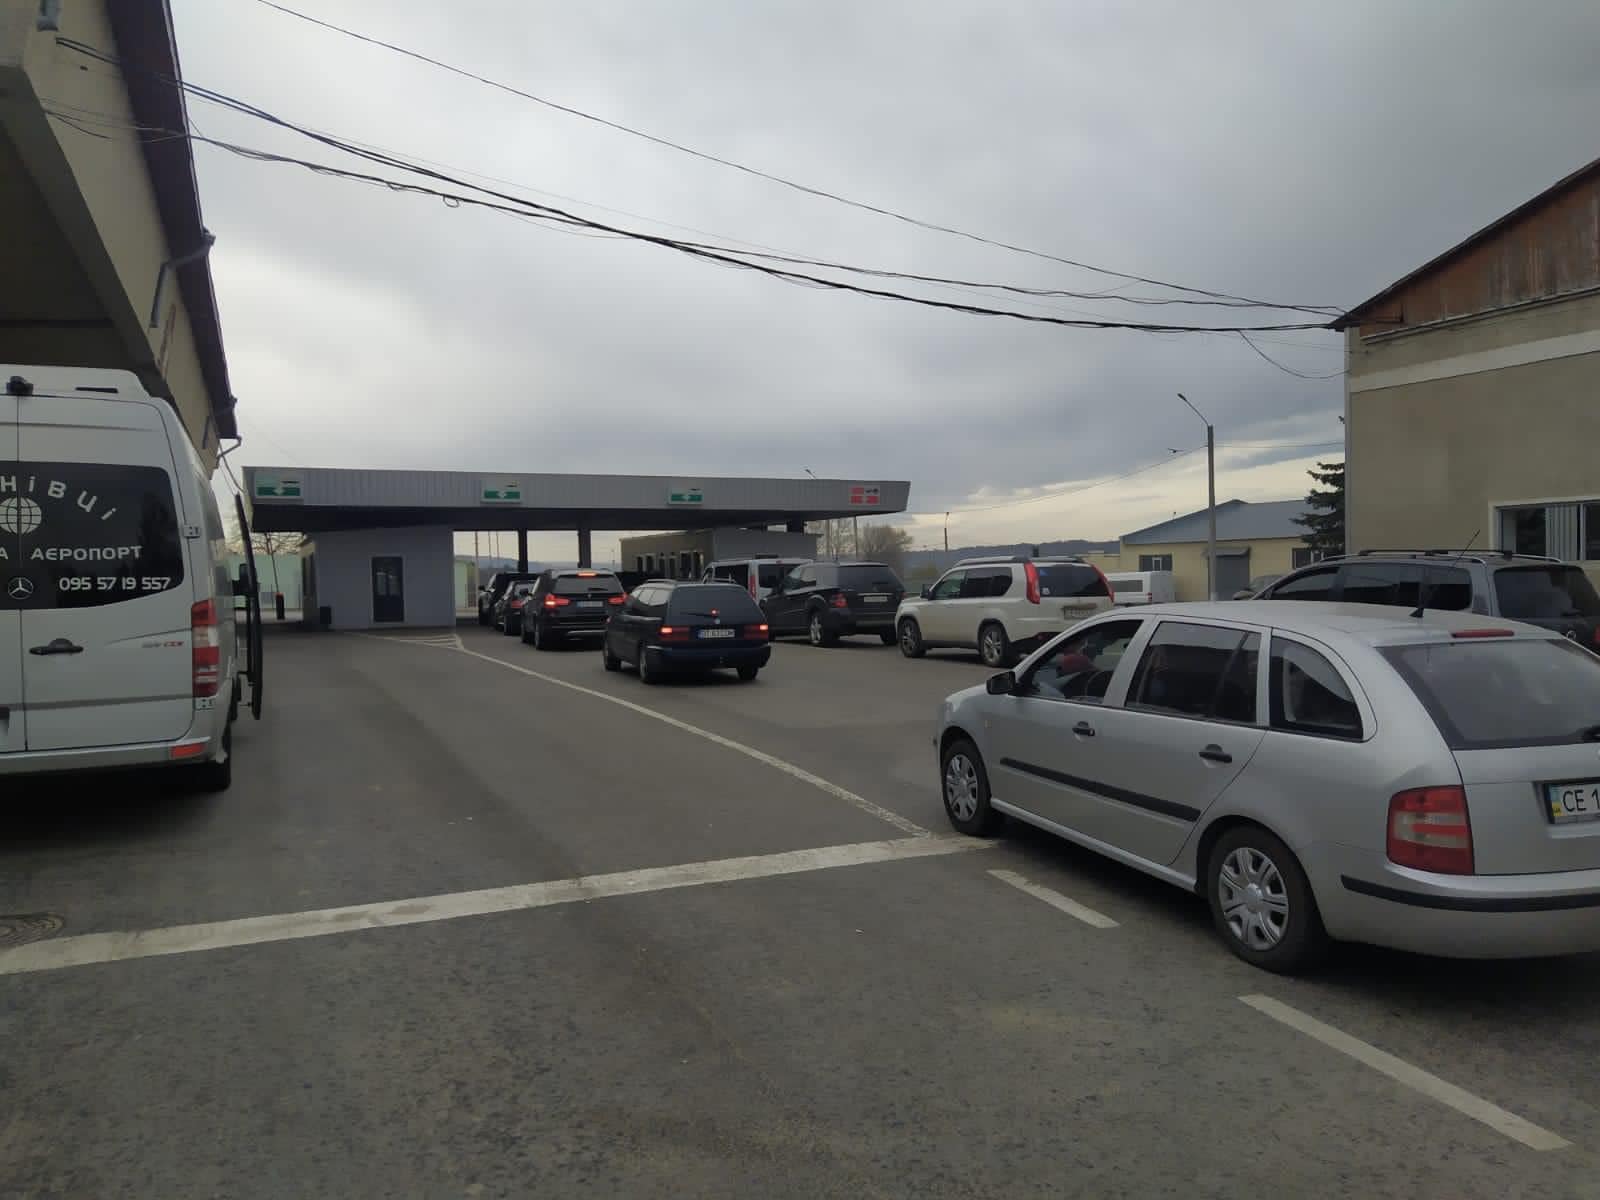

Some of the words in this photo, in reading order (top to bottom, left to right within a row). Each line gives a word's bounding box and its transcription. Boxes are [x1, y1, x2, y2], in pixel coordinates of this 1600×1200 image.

[59, 577, 91, 590] 095
[97, 577, 116, 590] 57
[122, 577, 137, 590] 19
[141, 577, 171, 590] 557
[1562, 789, 1587, 812] CE
